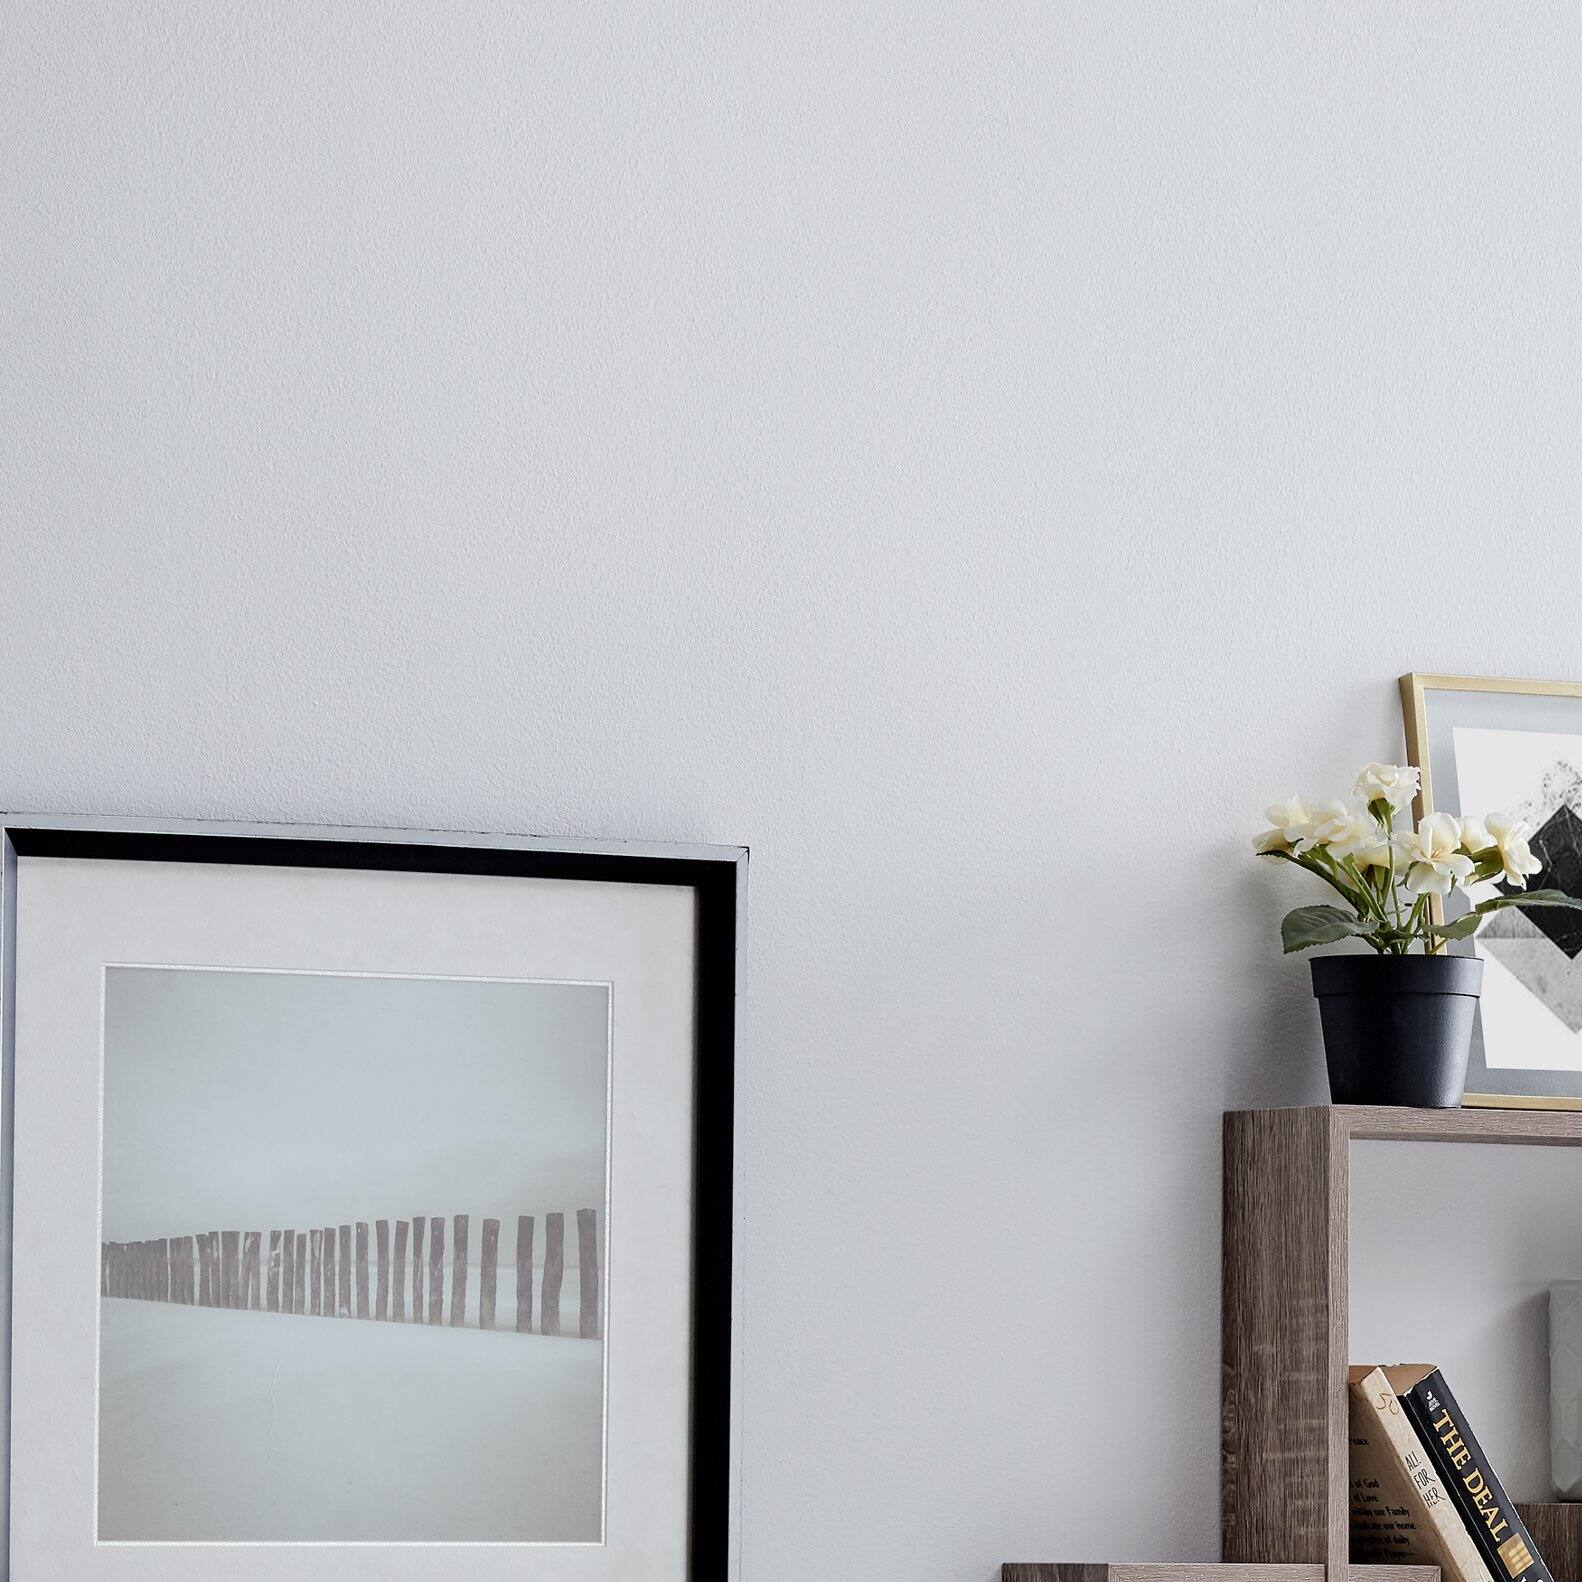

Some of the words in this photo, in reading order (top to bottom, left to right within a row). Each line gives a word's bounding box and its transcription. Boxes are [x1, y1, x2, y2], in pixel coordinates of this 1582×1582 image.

[1413, 1468, 1436, 1490] FOR
[1432, 1408, 1472, 1471] THE
[1462, 1467, 1509, 1543] DEAL
[1422, 1486, 1446, 1509] HER
